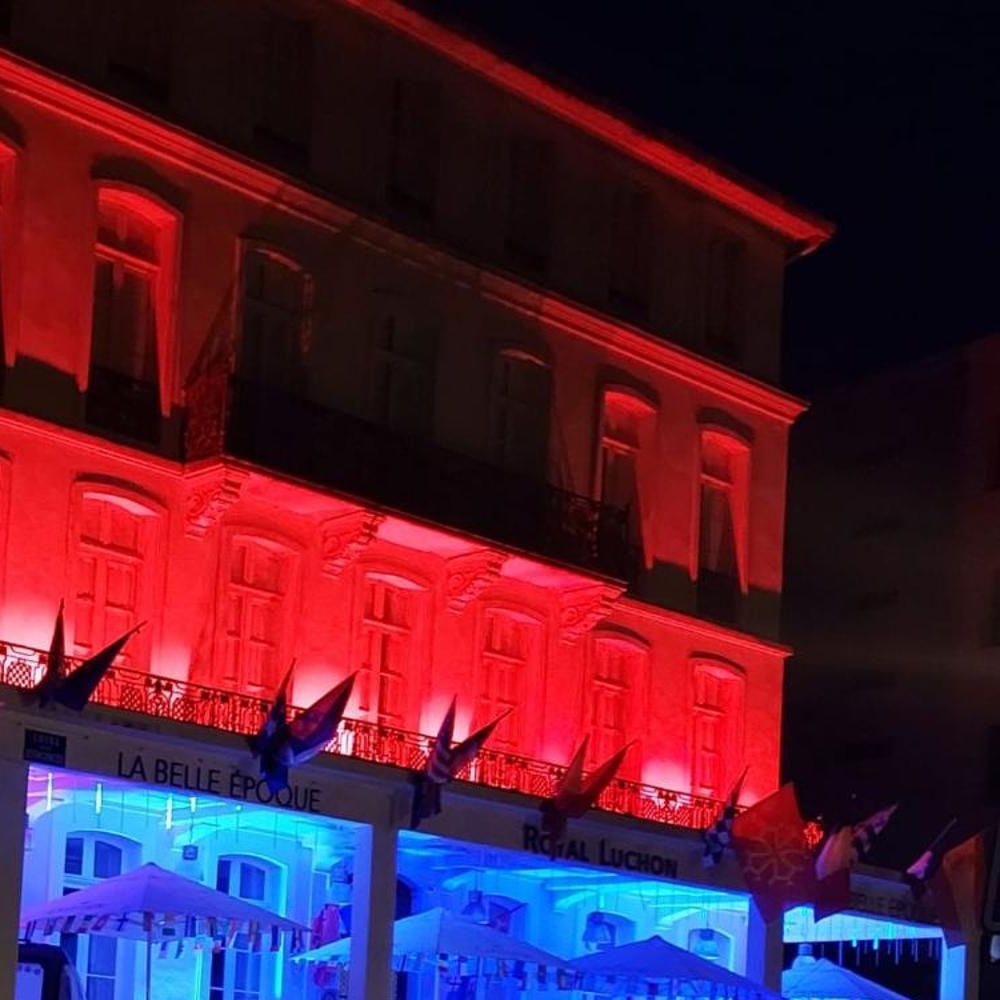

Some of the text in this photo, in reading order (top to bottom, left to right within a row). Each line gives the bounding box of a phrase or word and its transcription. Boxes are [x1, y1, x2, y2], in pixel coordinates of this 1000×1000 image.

[117, 751, 322, 813] LA BELLE ÉPOQUE
[599, 838, 678, 878] LUCHON
